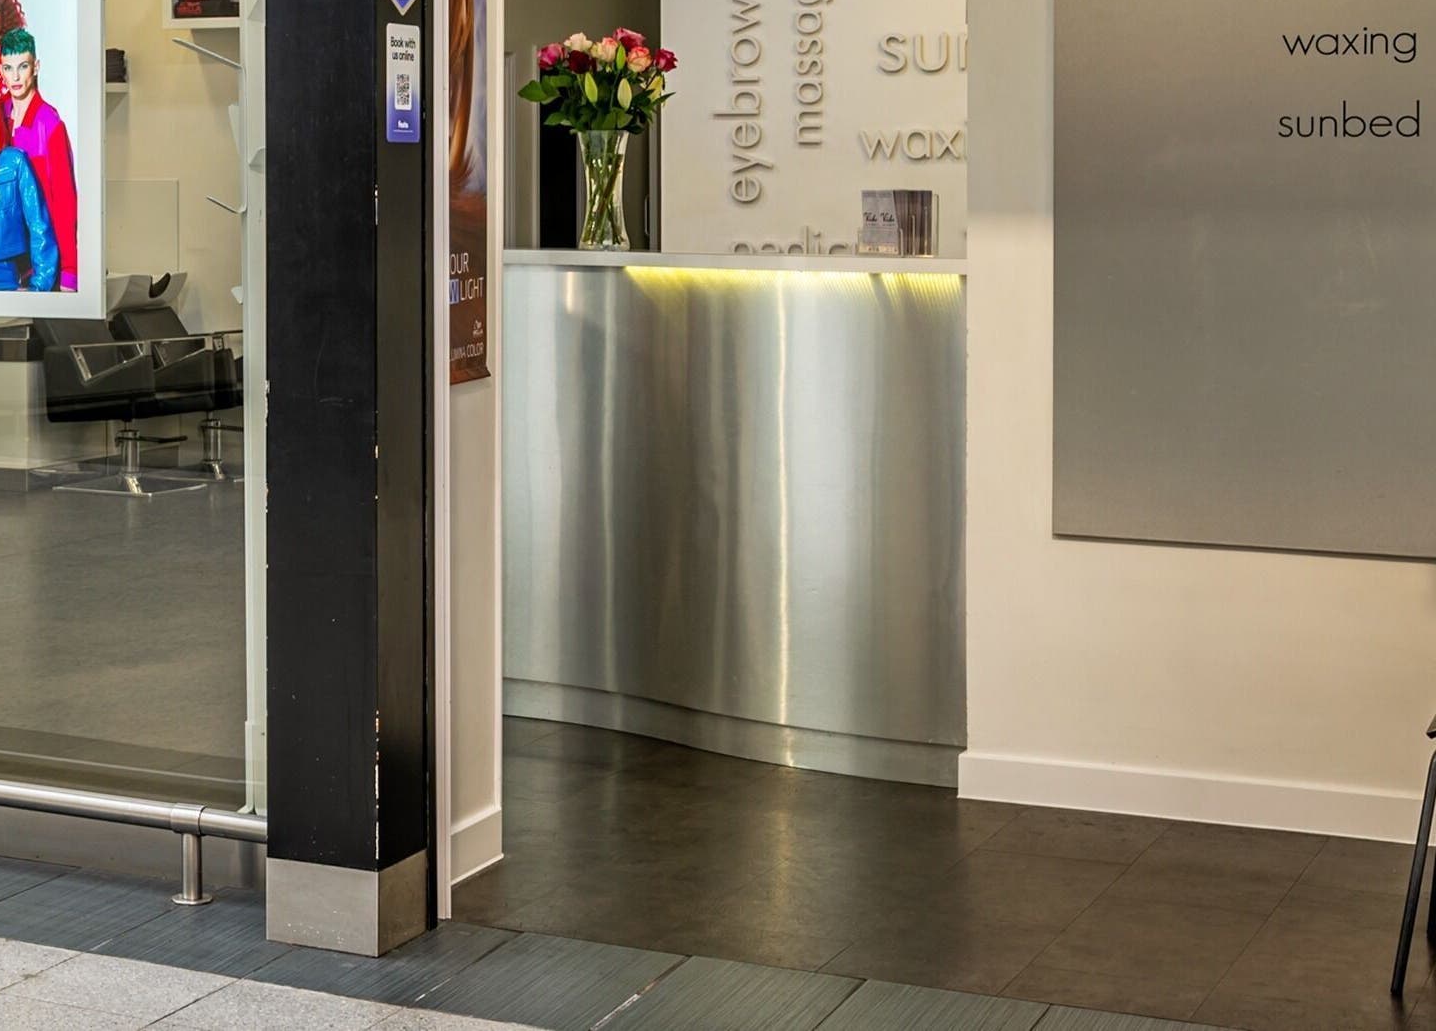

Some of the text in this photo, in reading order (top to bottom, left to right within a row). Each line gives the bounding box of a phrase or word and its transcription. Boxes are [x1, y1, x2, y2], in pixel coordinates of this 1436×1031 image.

[390, 36, 417, 49] Book with
[1282, 26, 1417, 64] waxing
[391, 50, 415, 62] us online
[1277, 99, 1420, 138] sunbed
[460, 276, 484, 301] LIGHT
